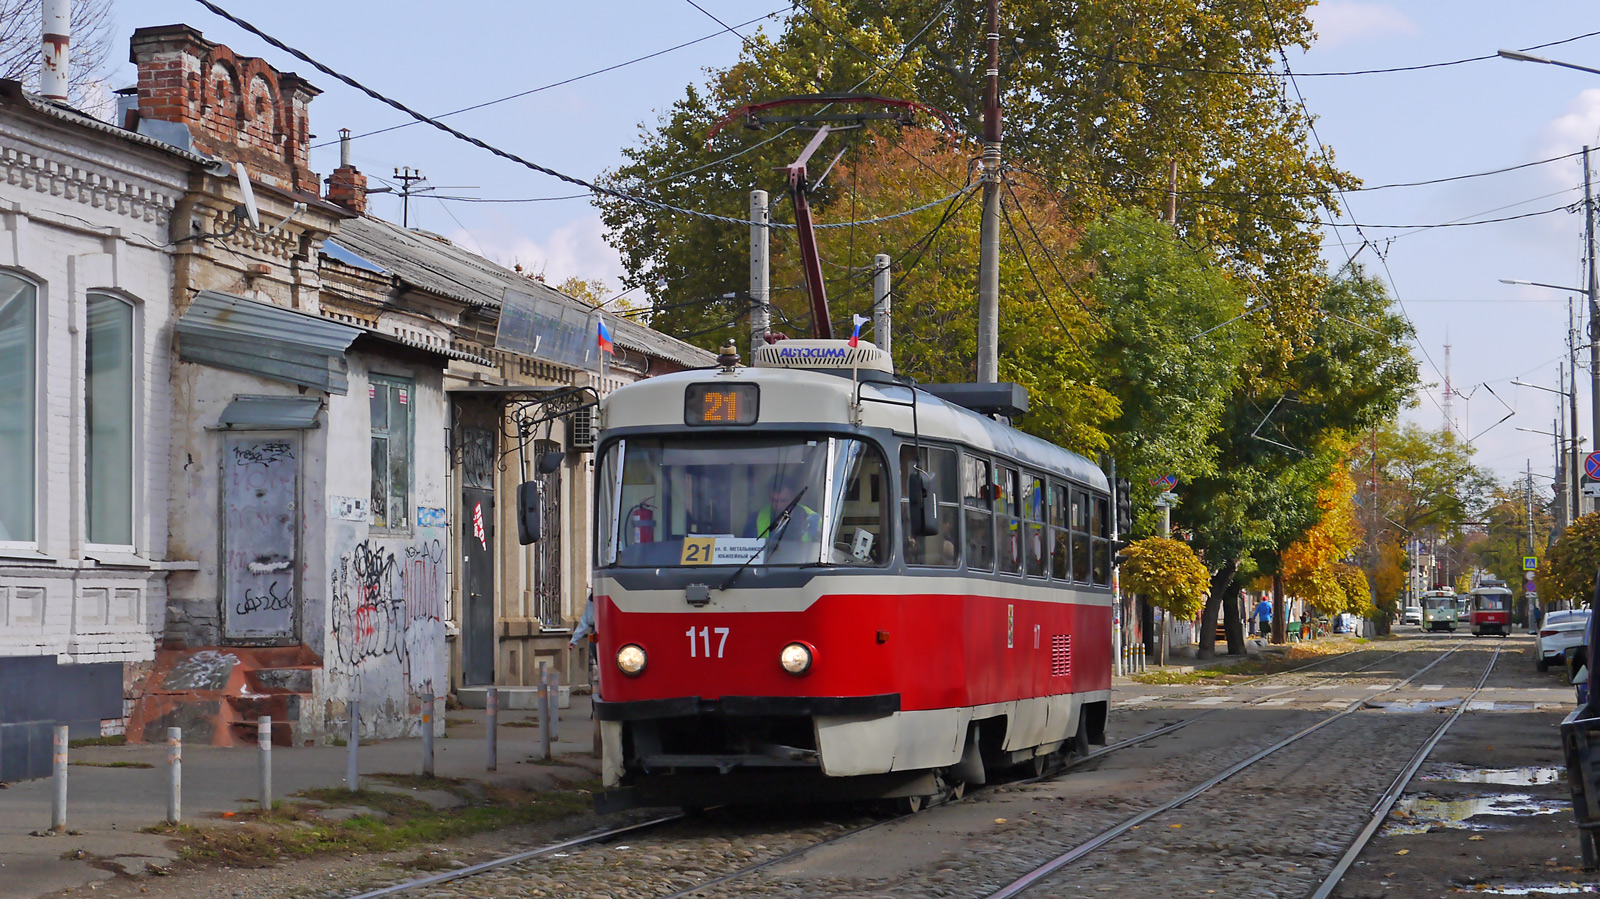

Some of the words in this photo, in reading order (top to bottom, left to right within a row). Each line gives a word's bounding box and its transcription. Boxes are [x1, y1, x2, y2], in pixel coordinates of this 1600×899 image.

[780, 347, 846, 358] AUTOCLIMA
[704, 392, 737, 421] 21
[685, 544, 711, 562] 21
[685, 626, 730, 659] 117
